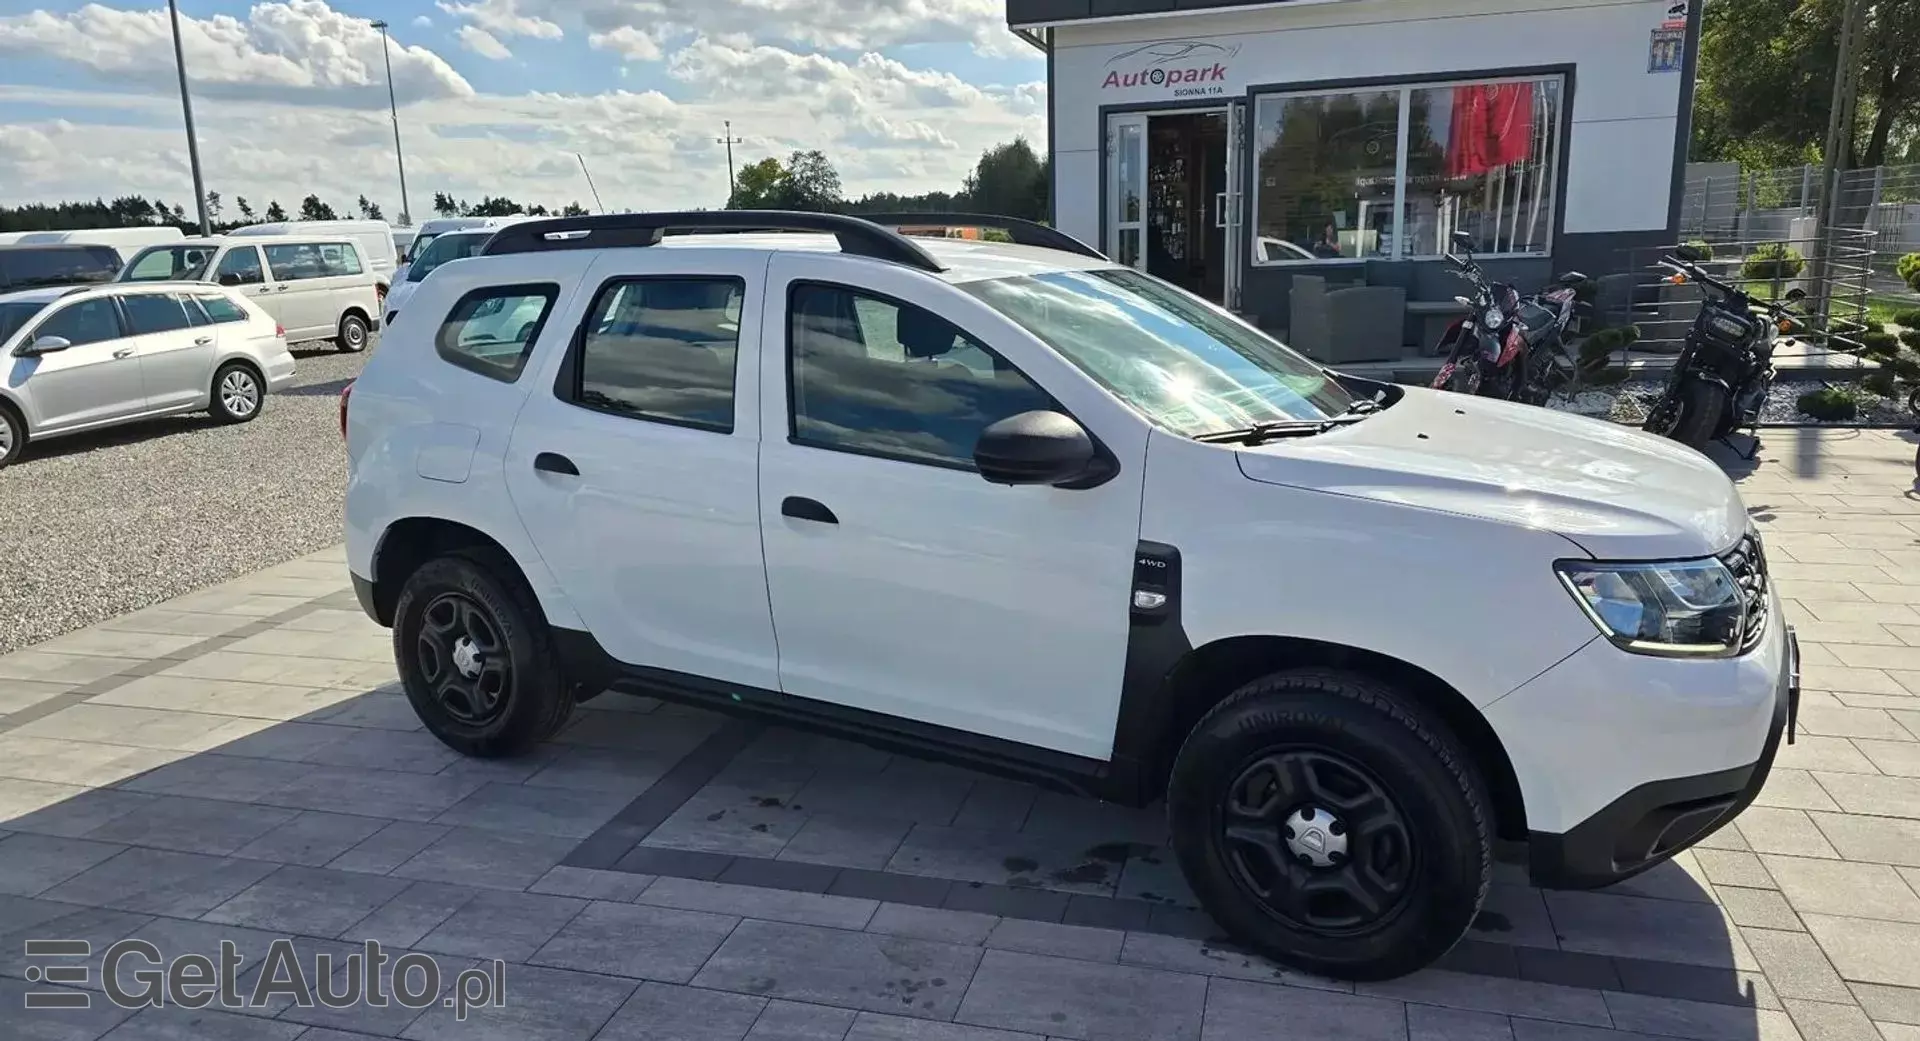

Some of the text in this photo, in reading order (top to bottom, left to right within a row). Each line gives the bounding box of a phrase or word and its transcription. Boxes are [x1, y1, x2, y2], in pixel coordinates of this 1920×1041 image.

[1101, 63, 1228, 89] Autopark
[1174, 86, 1223, 97] SIONNA 11A
[1138, 558, 1166, 568] 4WD
